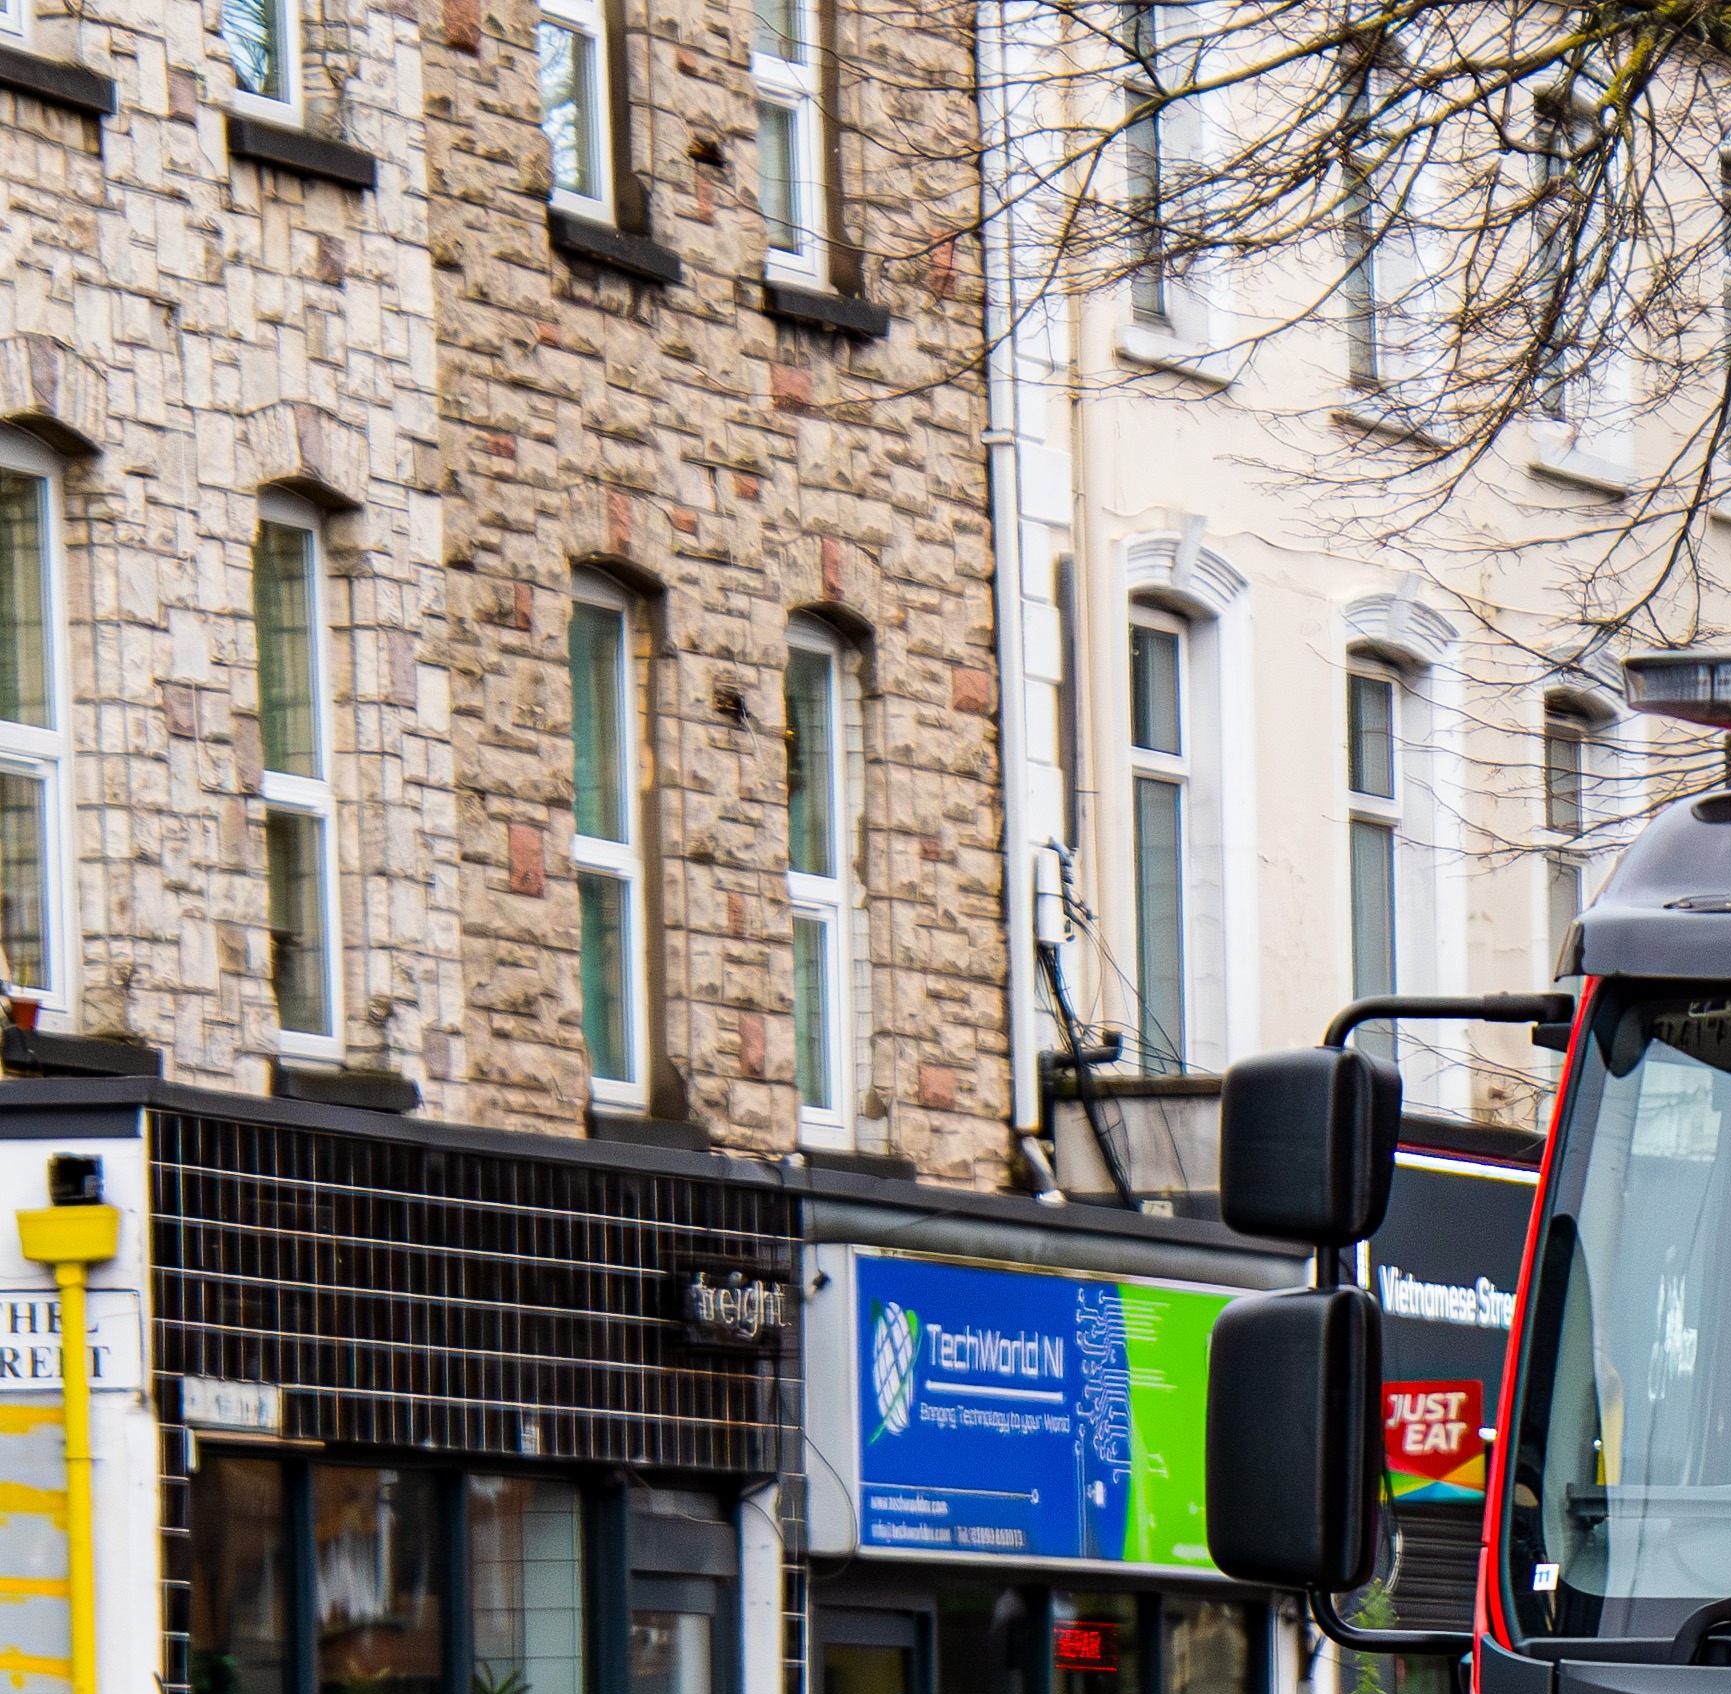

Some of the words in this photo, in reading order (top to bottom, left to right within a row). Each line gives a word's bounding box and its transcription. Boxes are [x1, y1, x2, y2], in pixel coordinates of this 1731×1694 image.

[1378, 1264, 1477, 1325] Vietnamese
[926, 1323, 1039, 1378] TechWorld
[1043, 1334, 1064, 1378] NI
[957, 1405, 1010, 1433] Technology
[1021, 1415, 1042, 1434] your
[1043, 1413, 1070, 1433] World
[1386, 1391, 1467, 1428] JUST
[1404, 1421, 1467, 1454] EAT
